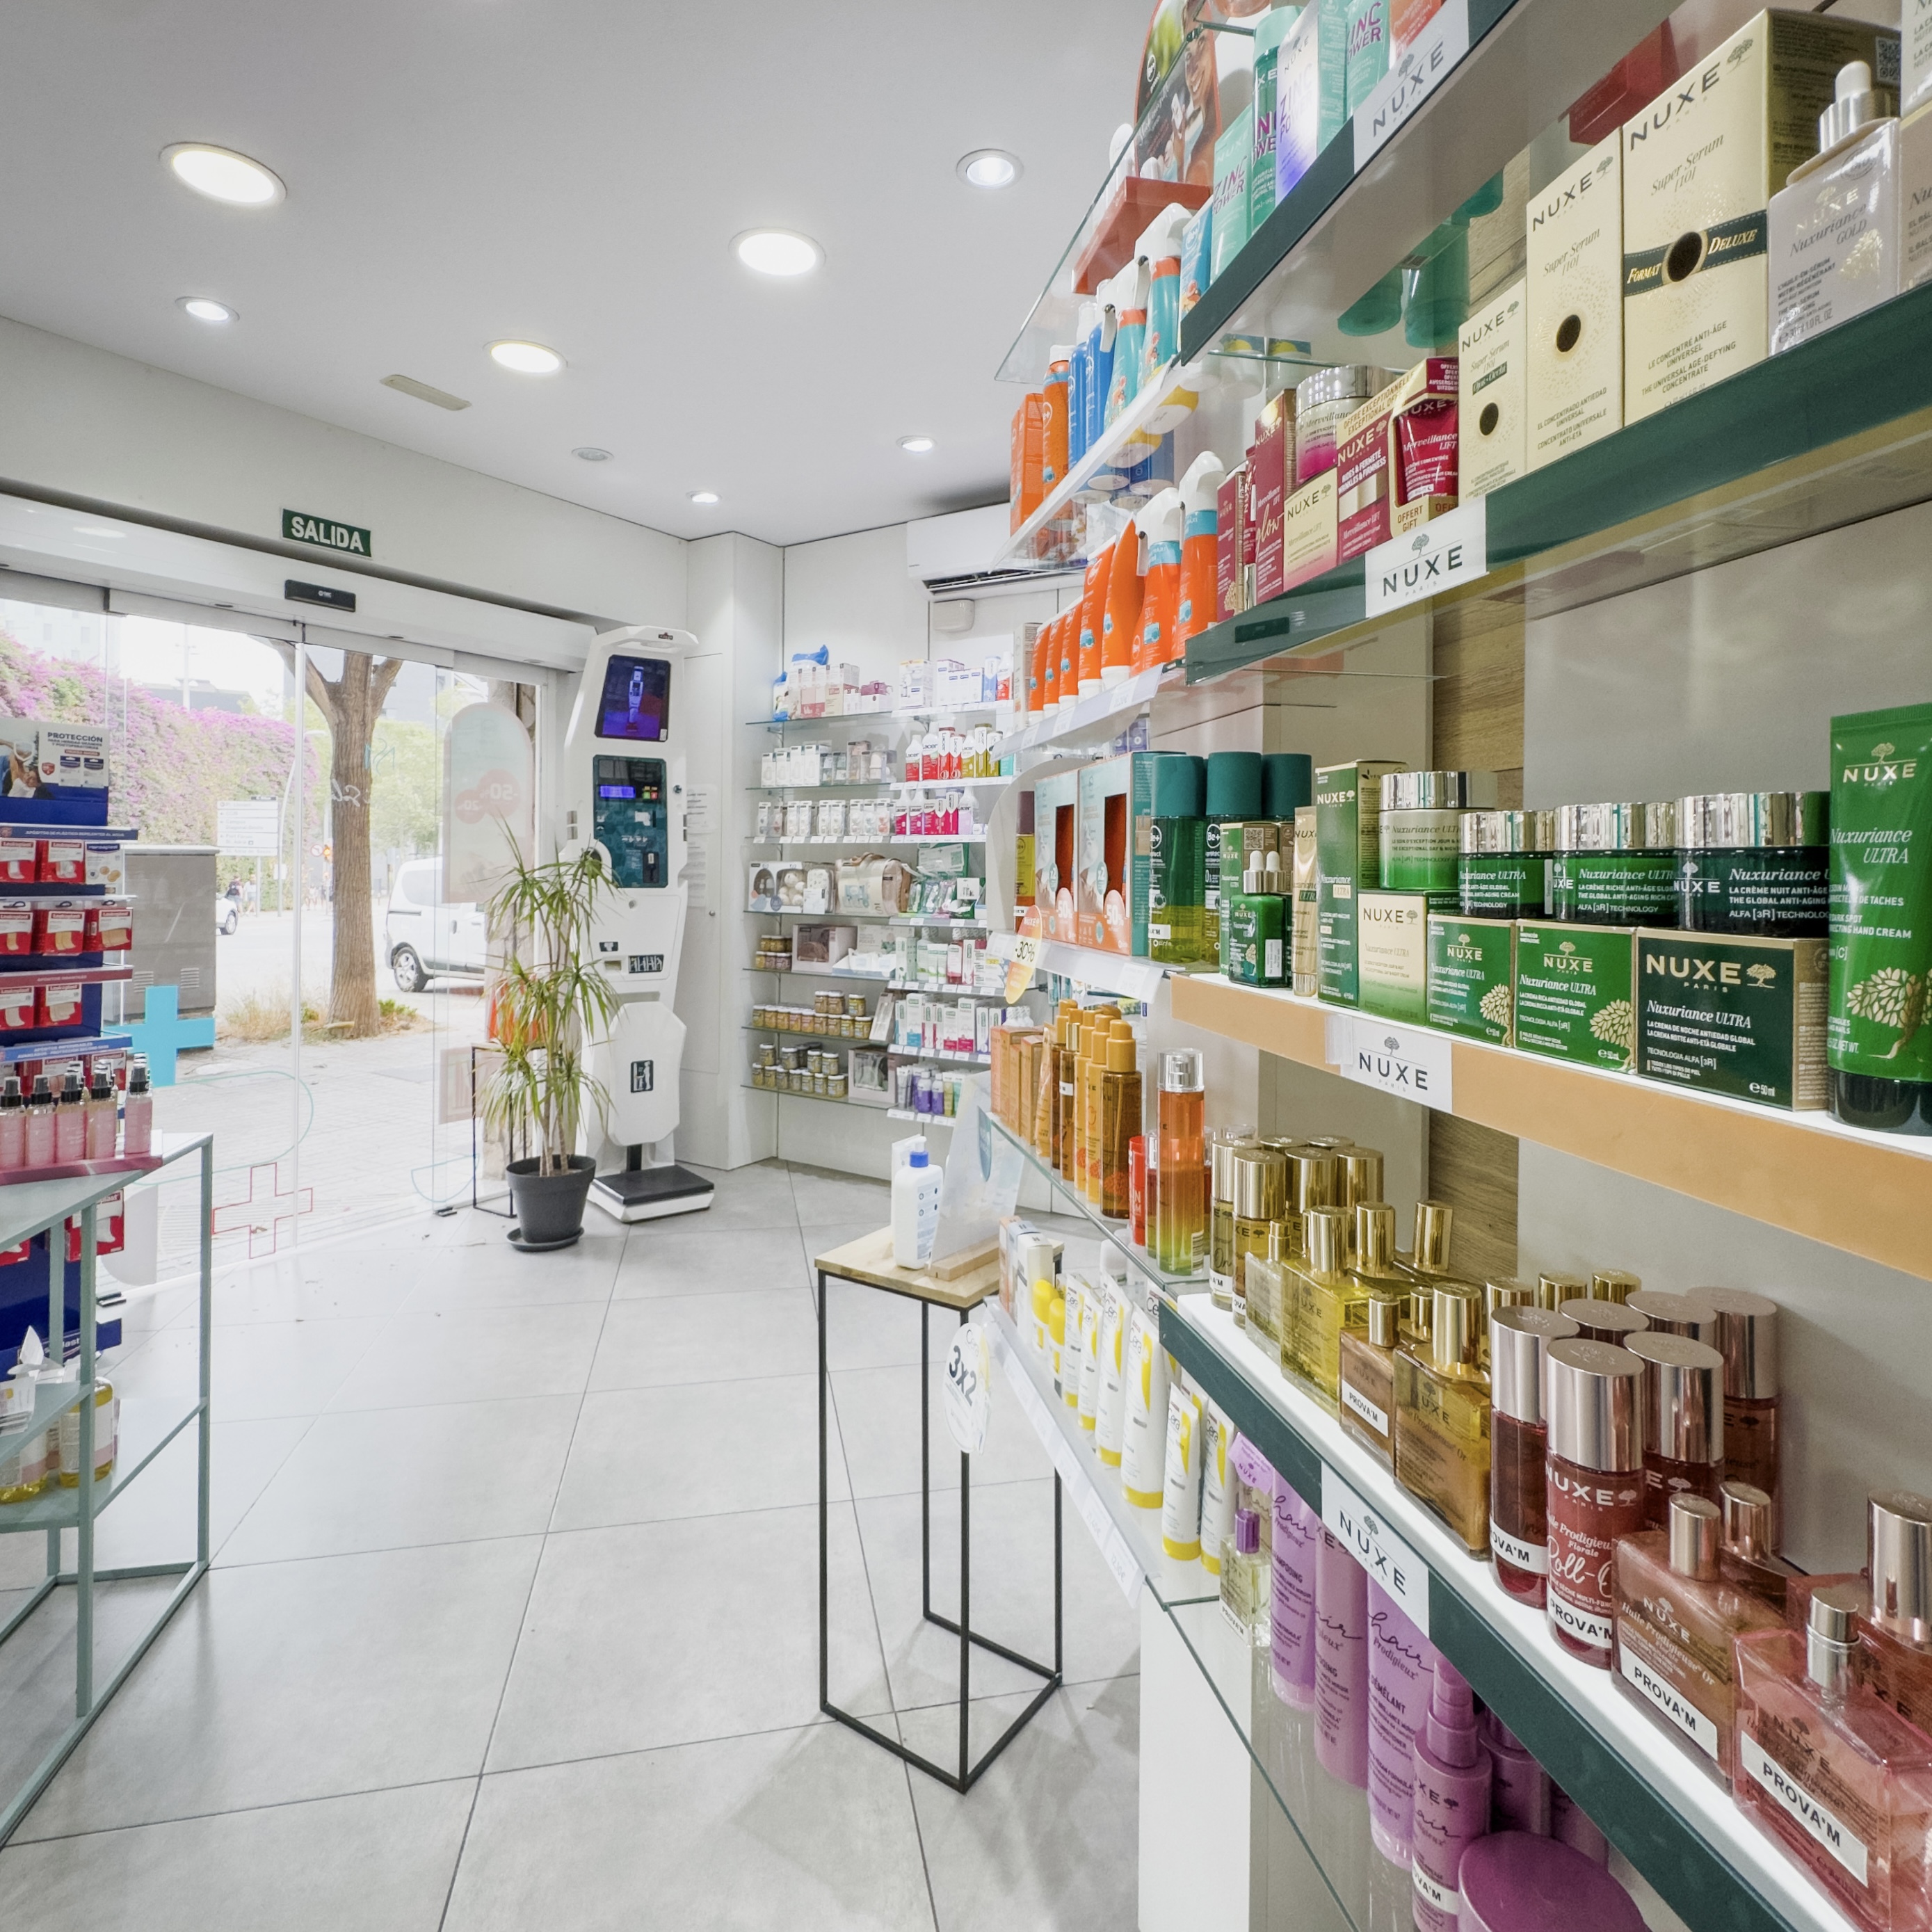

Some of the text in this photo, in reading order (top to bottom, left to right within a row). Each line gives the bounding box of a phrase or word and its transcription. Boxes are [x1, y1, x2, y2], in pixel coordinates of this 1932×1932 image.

[1285, 35, 1309, 74] NUXE
[1373, 41, 1444, 138] NUXE
[1630, 62, 1721, 152] NUXE
[1651, 134, 1724, 196] Super Serum
[1533, 171, 1592, 232] NUXE
[1789, 203, 1867, 257] Nuxuriance
[1836, 218, 1867, 245] GOLD
[1543, 228, 1600, 277] Super Serum
[1627, 229, 1758, 284] FORMAT DELUXE
[1462, 310, 1505, 353] NUXE
[1488, 339, 1510, 357] Serum
[1648, 320, 1728, 370] LE CONCENTRÉ ANTI-ÂGE
[1667, 344, 1703, 369] UNIVERSEL
[1641, 383, 1652, 396] THE
[1653, 366, 1687, 389] UNIVERSAL
[1688, 340, 1737, 370] AGE-DEFYING
[1662, 363, 1709, 394] CONCENTRATE
[1343, 407, 1362, 430] OFFRE
[1544, 401, 1580, 428] CONCENTRADO
[1580, 387, 1608, 407] ANTIEDAD
[1556, 408, 1585, 428] UNIVERSAL
[1348, 403, 1385, 436] EXCEPTIONAL
[1537, 408, 1607, 451] CONCENTRATO UNIVERSALE
[1256, 422, 1278, 446] NUXE
[1403, 432, 1458, 451] Merveillance
[1337, 427, 1376, 467] NUXE
[1439, 442, 1458, 451] LIFT
[1359, 446, 1382, 471] FERMETÉ
[1362, 456, 1387, 478] FIRMNESS
[1287, 492, 1319, 522] NUXE
[1397, 505, 1423, 524] OFFERT
[291, 516, 364, 552] SALIDA
[1256, 502, 1285, 561] glow
[1403, 520, 1417, 533] GIFT
[1383, 545, 1463, 597] NUXE
[1405, 580, 1438, 598] PARIS
[47, 732, 103, 743] PROTECCIÓN
[1843, 763, 1917, 783] NUXE
[1317, 791, 1346, 804] NUXE
[1392, 825, 1440, 834] Nuxuriance
[1830, 827, 1913, 844] Nuxuriance
[1863, 848, 1909, 864] ULTRA
[1498, 871, 1527, 880] ULTRA
[1579, 869, 1645, 880] Nuxuriance
[1729, 868, 1826, 881] Nuxuriance
[1673, 880, 1721, 893] NUXE
[1741, 885, 1769, 894] CRÈME
[1791, 885, 1828, 895] ANTI-ÂGE
[1870, 896, 1904, 906] TACHES
[1364, 908, 1403, 924] NUXE
[1753, 909, 1776, 920] [3R]
[1845, 914, 1862, 924] SPOT
[1853, 926, 1911, 939] HAND CREAM
[1015, 942, 1035, 962] -30%
[1447, 947, 1482, 960] NUXE
[1544, 956, 1593, 973] NUXE
[1646, 954, 1741, 985] NUXE
[1520, 974, 1597, 996] Nuxuriance ULTRA
[1683, 982, 1728, 992] PARIS
[1647, 1000, 1751, 1029] Nuxuriance ULTRA
[1710, 1041, 1737, 1052] GLOBALE
[1730, 1035, 1756, 1045] GLOBAL
[1647, 1047, 1684, 1060] TECNOLOGIA
[1684, 1054, 1700, 1064] ALFA
[1360, 1052, 1428, 1090] NUXE
[1378, 1079, 1406, 1093] PARIS
[1349, 1392, 1378, 1422] PROVA'M
[1237, 1463, 1257, 1484] NUXE
[1545, 1461, 1614, 1506] NUXE
[1340, 1510, 1406, 1596] NUXE
[1568, 1540, 1599, 1558] Florale
[1643, 1596, 1691, 1643] NUXE
[1368, 1611, 1434, 1674] hair
[1621, 1601, 1716, 1686] Huile Or
[1634, 1666, 1696, 1732] PROVA'M
[1763, 1762, 1840, 1847] PROVA'M
